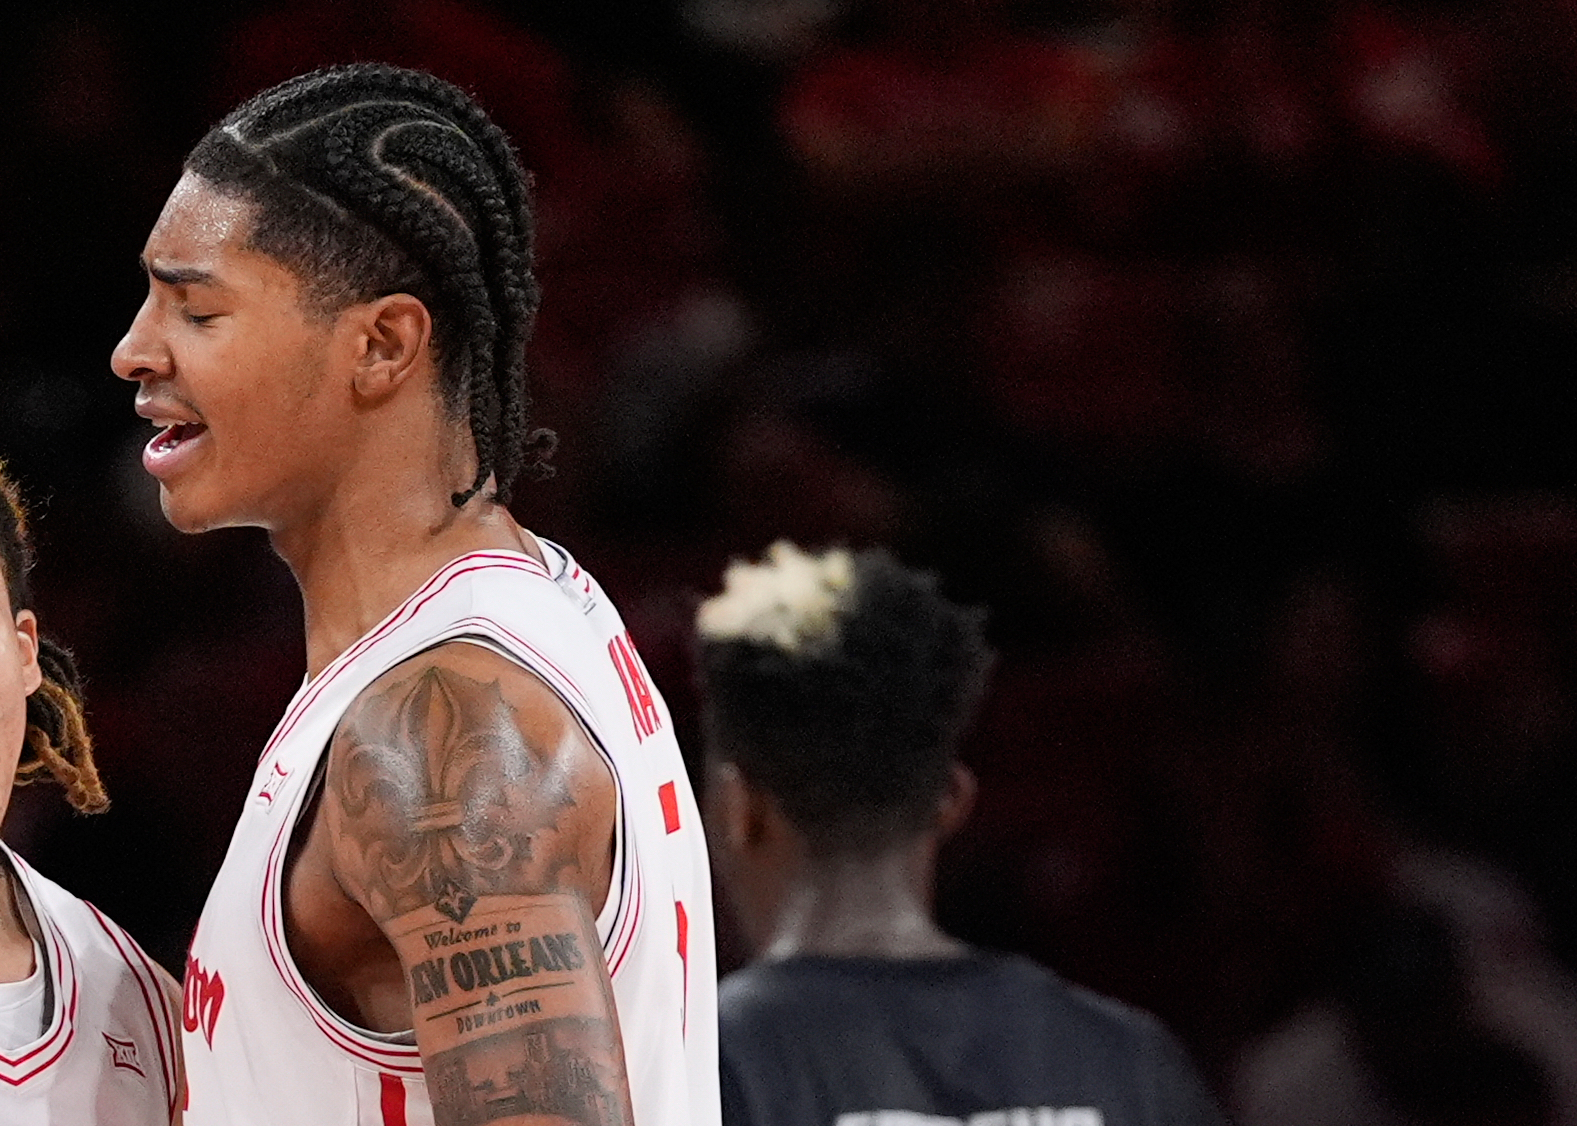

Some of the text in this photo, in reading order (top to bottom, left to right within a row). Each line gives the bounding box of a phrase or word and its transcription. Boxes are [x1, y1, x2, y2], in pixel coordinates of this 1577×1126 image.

[424, 920, 522, 950] Welcome to
[450, 932, 585, 992] ORLEANS
[455, 999, 541, 1034] DOWNTOWN
